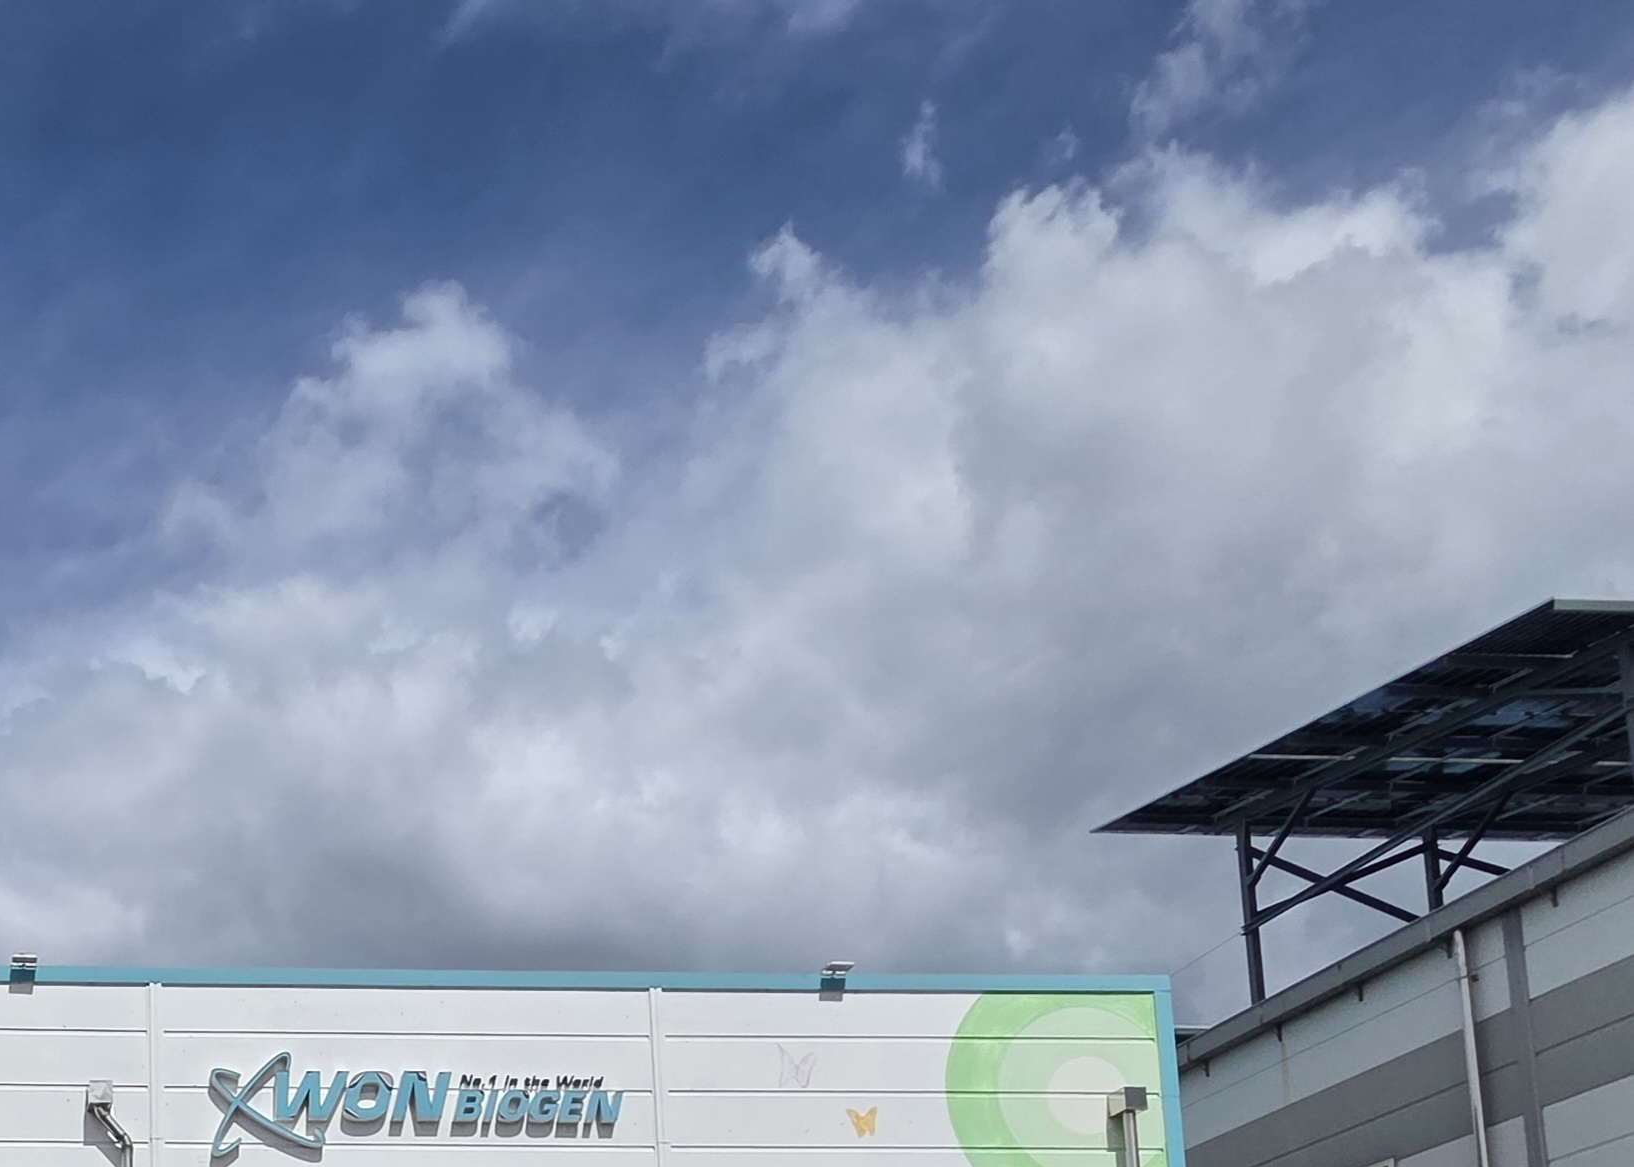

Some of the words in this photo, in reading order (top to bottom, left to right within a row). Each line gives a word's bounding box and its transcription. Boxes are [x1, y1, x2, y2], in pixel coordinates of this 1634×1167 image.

[274, 1070, 452, 1122] WON
[454, 1089, 624, 1126] BIOGEN
[524, 1076, 550, 1089] the
[556, 1075, 604, 1089] World
